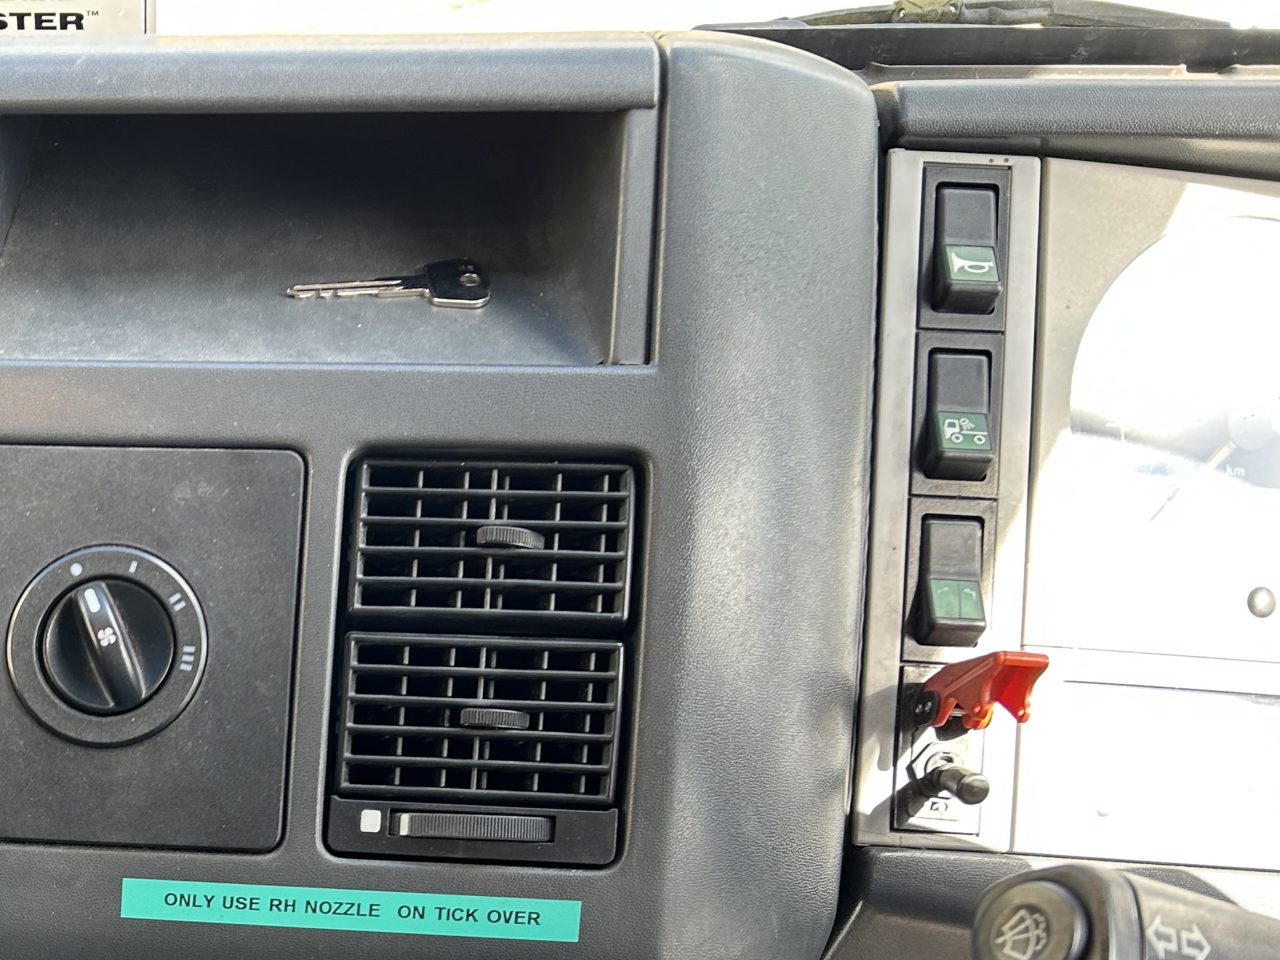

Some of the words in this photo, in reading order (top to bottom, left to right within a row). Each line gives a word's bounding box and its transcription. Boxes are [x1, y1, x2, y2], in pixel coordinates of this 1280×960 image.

[1225, 465, 1246, 477] km
[164, 892, 216, 909] ONLY
[222, 895, 261, 911] USE
[269, 898, 296, 913] RH
[304, 900, 381, 918] NOZZLE
[397, 905, 426, 920] ON
[435, 907, 479, 923] TICK
[486, 909, 541, 926] OVER
